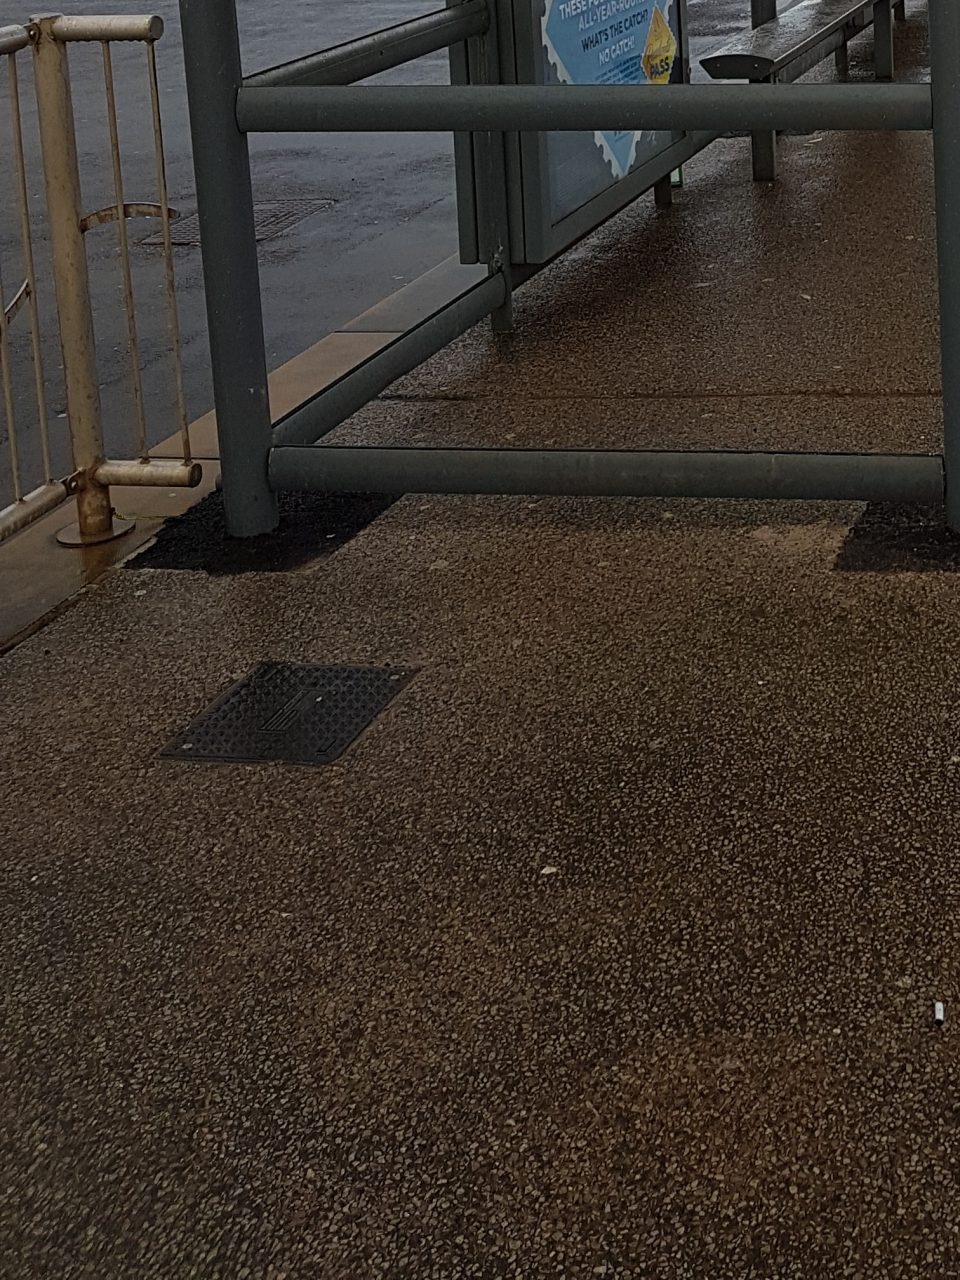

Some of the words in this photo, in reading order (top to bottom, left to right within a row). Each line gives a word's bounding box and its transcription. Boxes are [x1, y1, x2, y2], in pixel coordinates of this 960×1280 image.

[581, 30, 609, 52] WHAT'S
[610, 22, 623, 39] THE
[624, 9, 648, 33] CATCH?
[599, 50, 610, 65] NO
[611, 36, 635, 57] CATCH!
[649, 56, 670, 78] PASS
